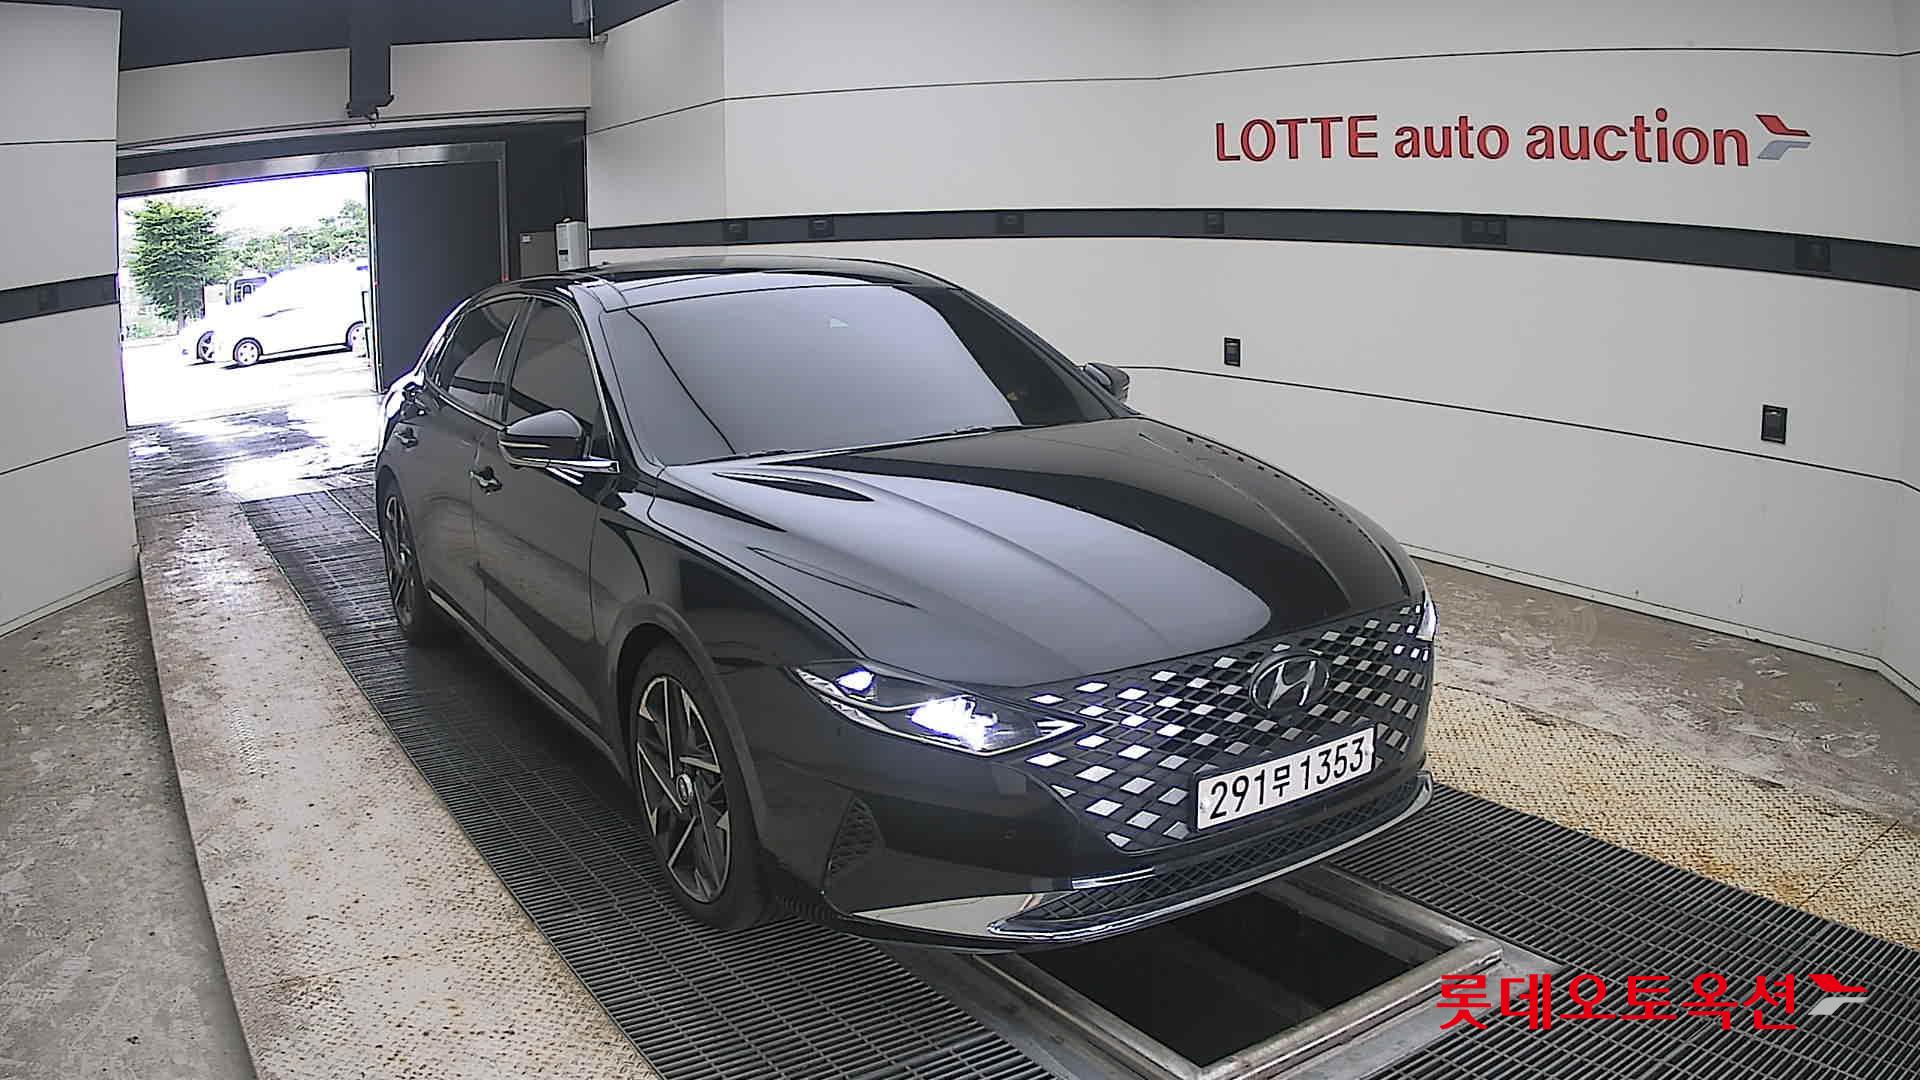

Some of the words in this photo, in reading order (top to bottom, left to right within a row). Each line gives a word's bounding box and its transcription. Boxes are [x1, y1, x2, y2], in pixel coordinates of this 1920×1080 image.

[1215, 115, 1378, 162] LOTTE
[1394, 115, 1509, 160] auto
[1525, 108, 1749, 166] auction
